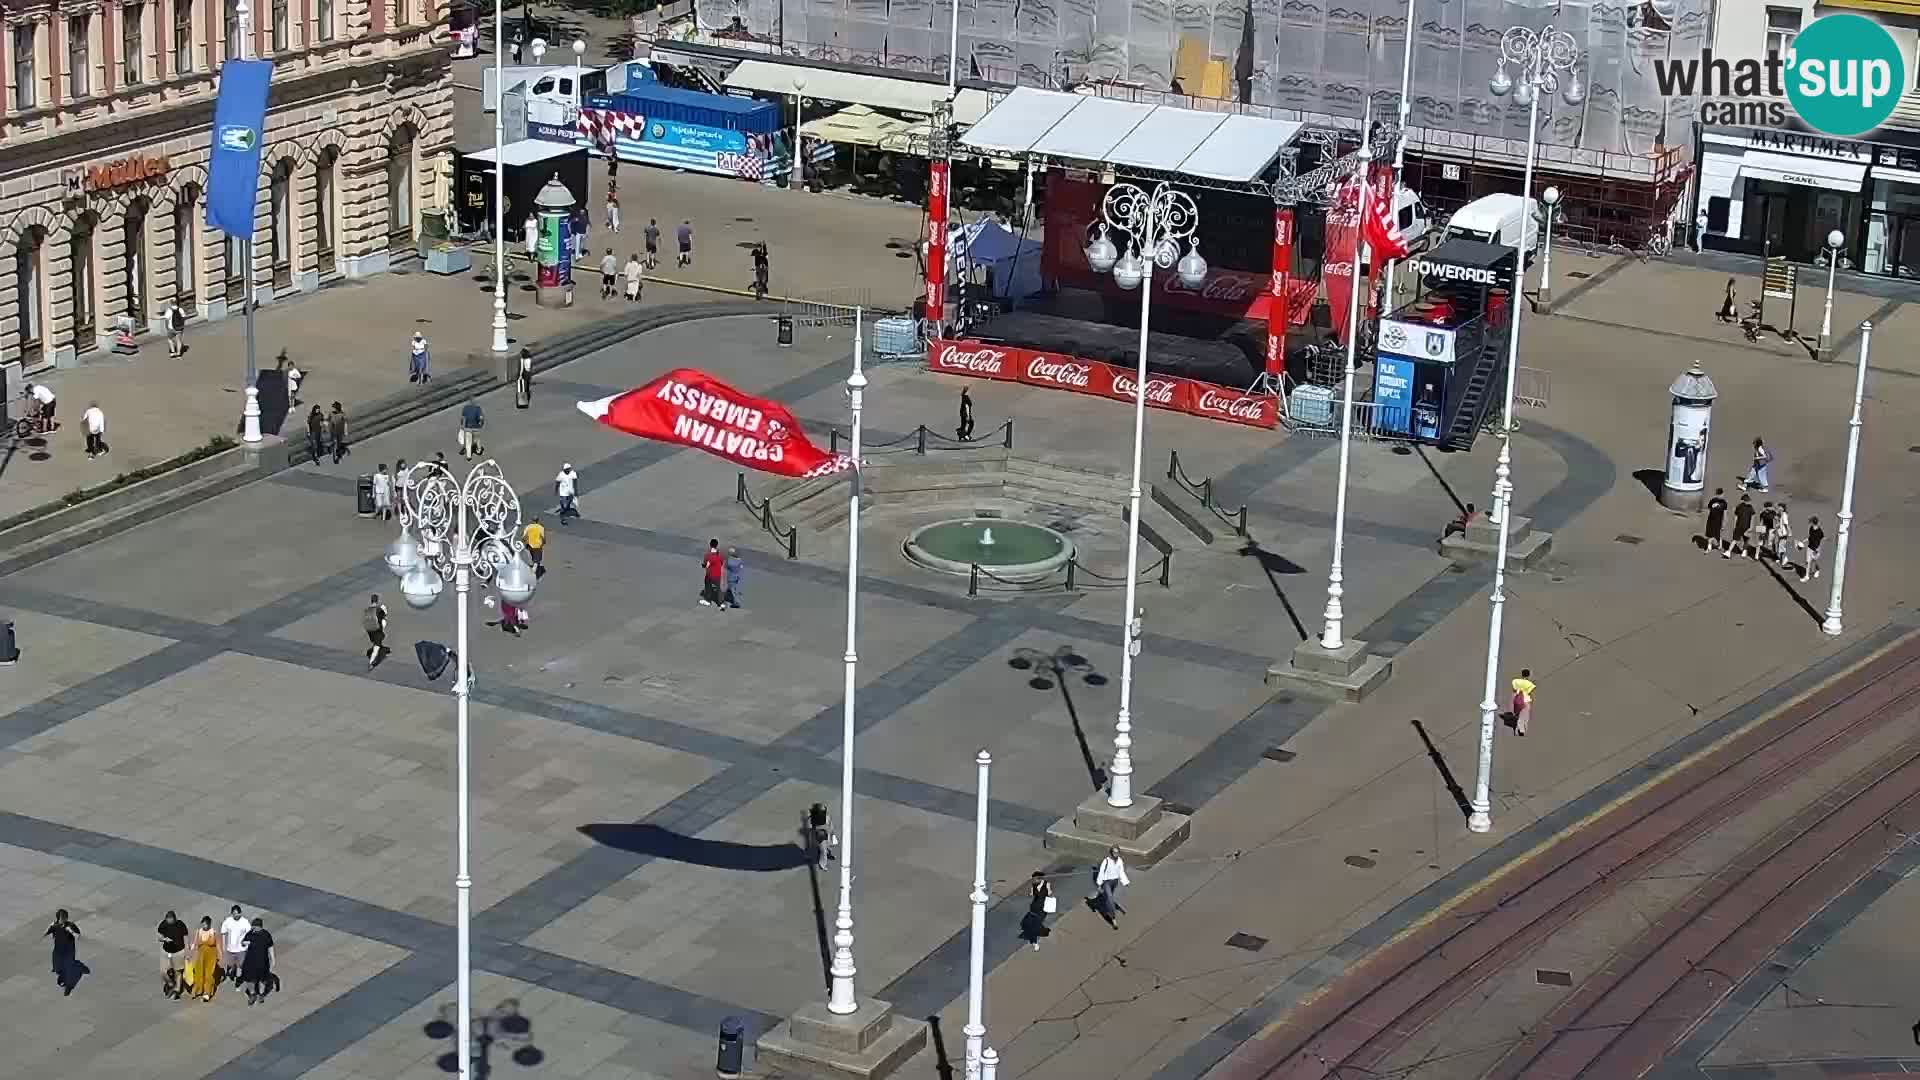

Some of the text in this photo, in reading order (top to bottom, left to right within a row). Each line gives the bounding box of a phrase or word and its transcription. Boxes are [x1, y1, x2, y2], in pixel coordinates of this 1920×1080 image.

[1751, 129, 1861, 160] MARTIMEX
[1782, 174, 1820, 186] CHANEL
[1408, 259, 1497, 285] POWERADE
[656, 380, 763, 433] EMBASSY
[673, 414, 784, 463] CROATIAN
